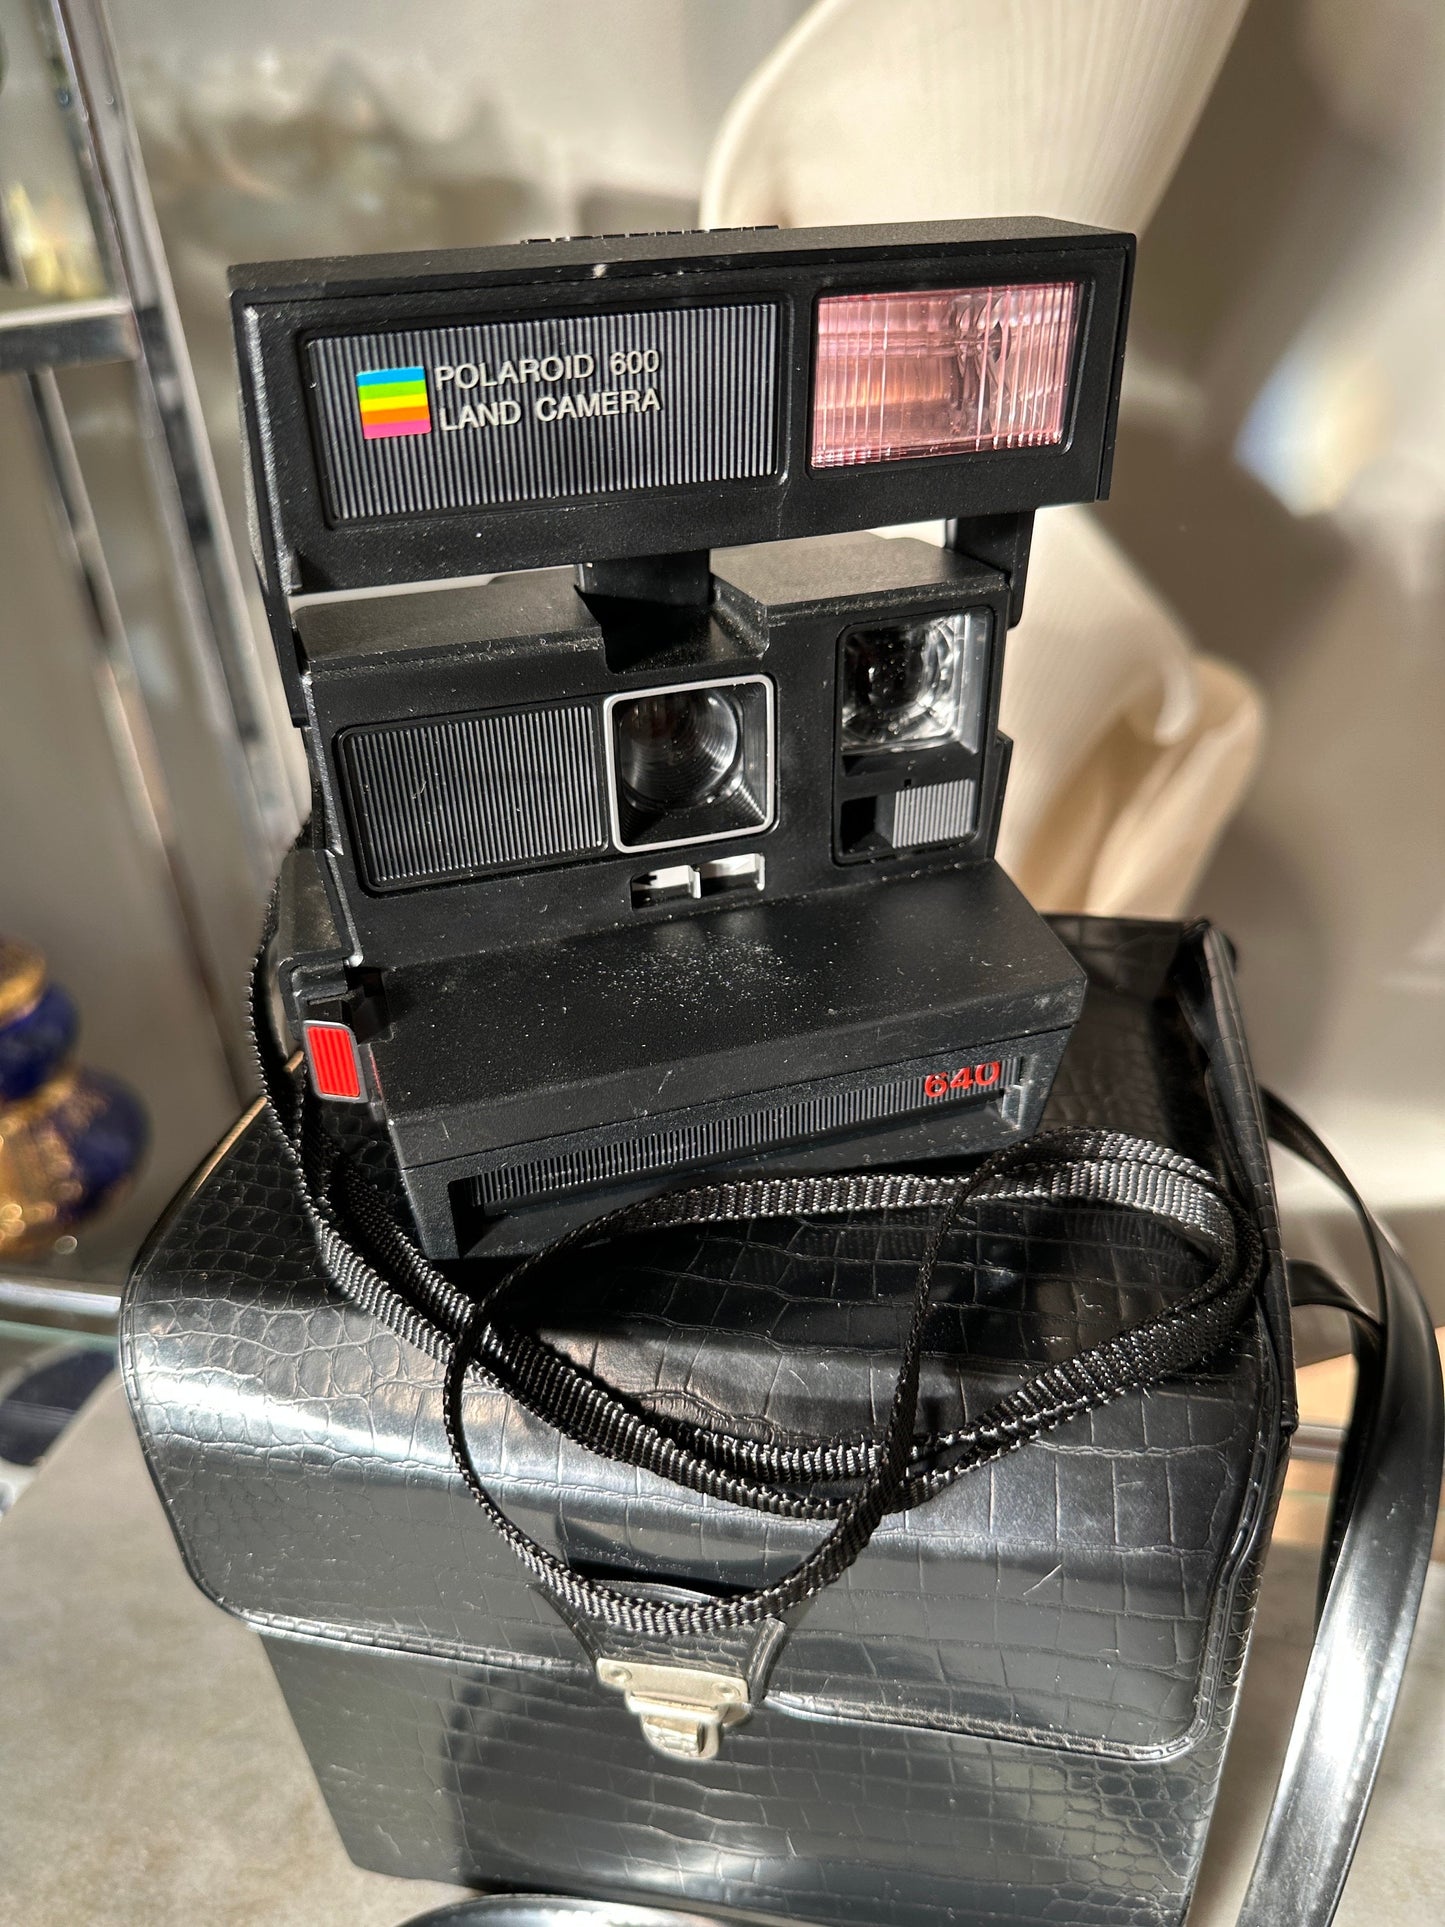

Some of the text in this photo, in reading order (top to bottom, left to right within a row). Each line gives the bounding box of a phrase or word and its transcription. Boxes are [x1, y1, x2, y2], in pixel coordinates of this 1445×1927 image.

[434, 349, 660, 391] POLAROID 600
[439, 387, 662, 432] LAND CAMERA
[924, 1060, 1001, 1098] 640
